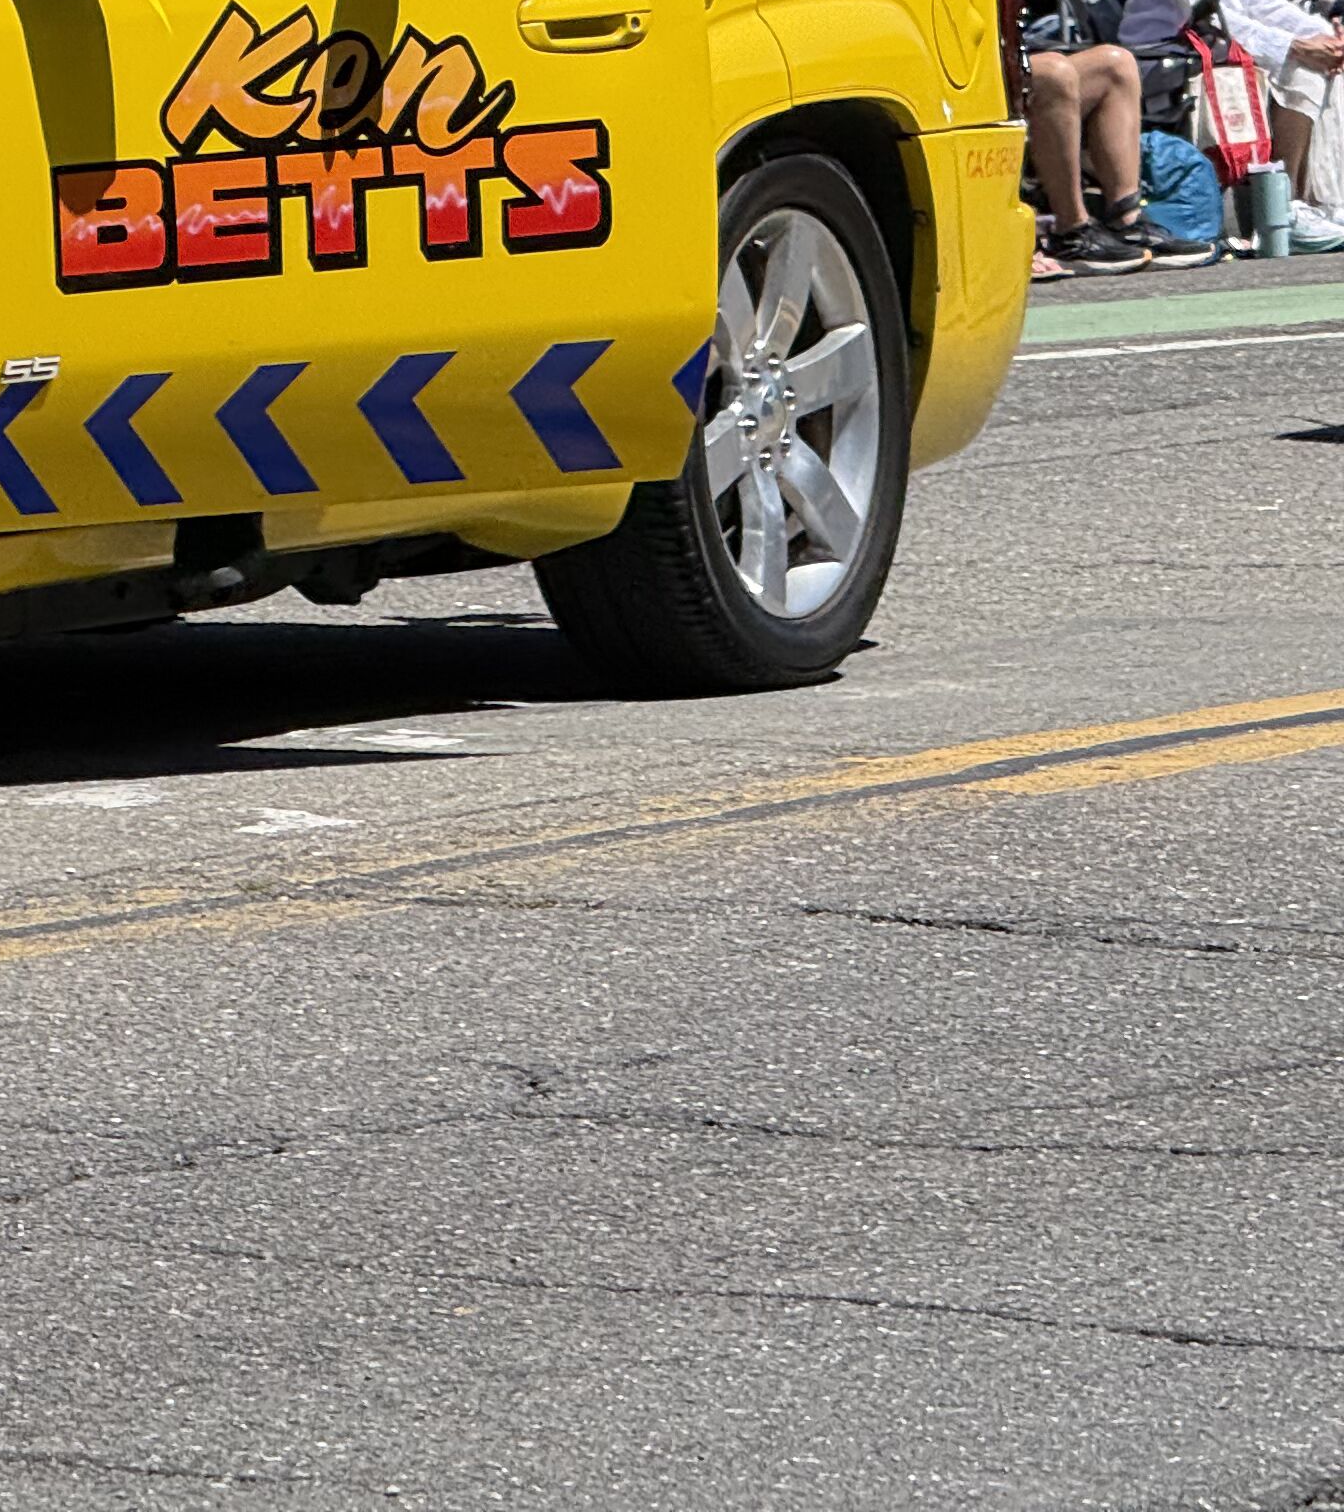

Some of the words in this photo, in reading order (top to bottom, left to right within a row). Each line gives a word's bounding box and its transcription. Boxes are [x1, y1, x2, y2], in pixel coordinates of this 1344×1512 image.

[160, 0, 515, 155] Ken
[54, 120, 611, 294] BETTS
[0, 354, 61, 385] SS
